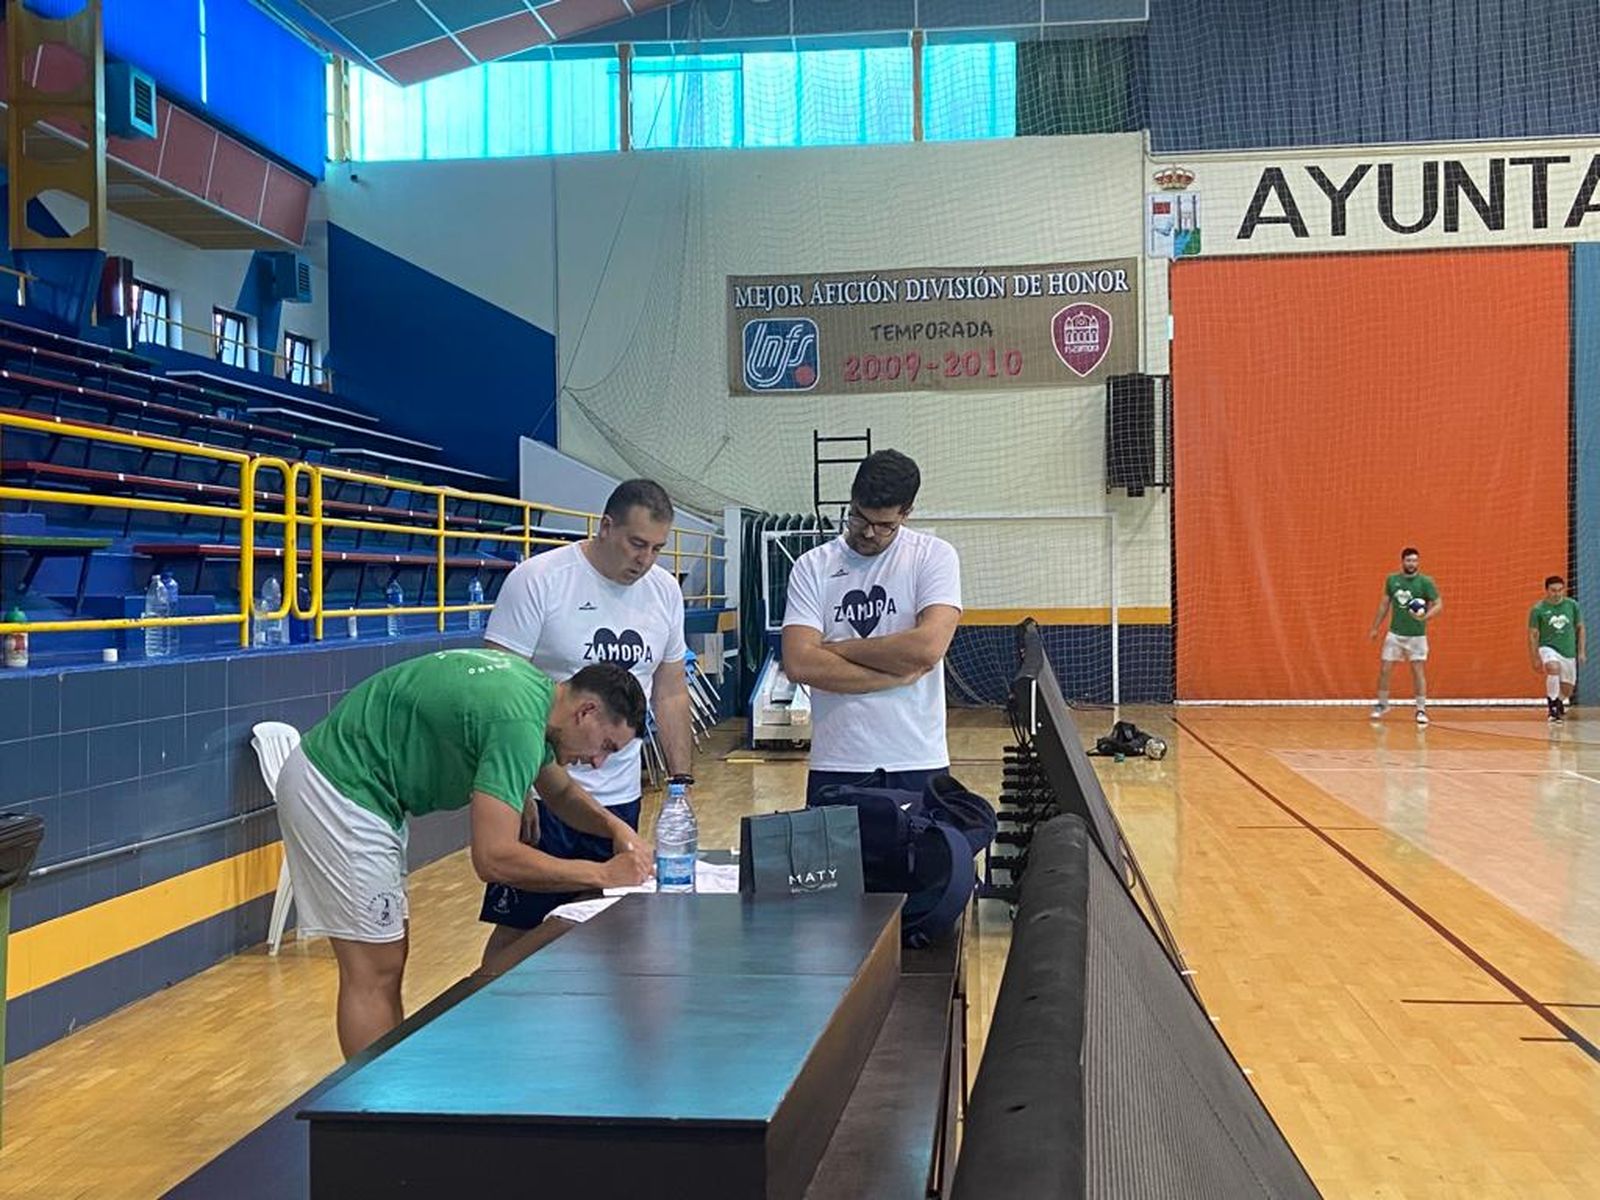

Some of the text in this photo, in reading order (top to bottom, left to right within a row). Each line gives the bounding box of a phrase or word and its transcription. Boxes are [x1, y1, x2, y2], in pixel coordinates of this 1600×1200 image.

[735, 283, 804, 311] MEJOR
[905, 270, 1006, 301] DIVISIÓN
[1012, 273, 1042, 297] DE
[1047, 268, 1130, 295] HONOR
[871, 321, 993, 342] TEMPORADA
[844, 349, 1023, 383] 2009-2010
[582, 642, 654, 663] ZAMORA
[788, 868, 837, 885] MATY
